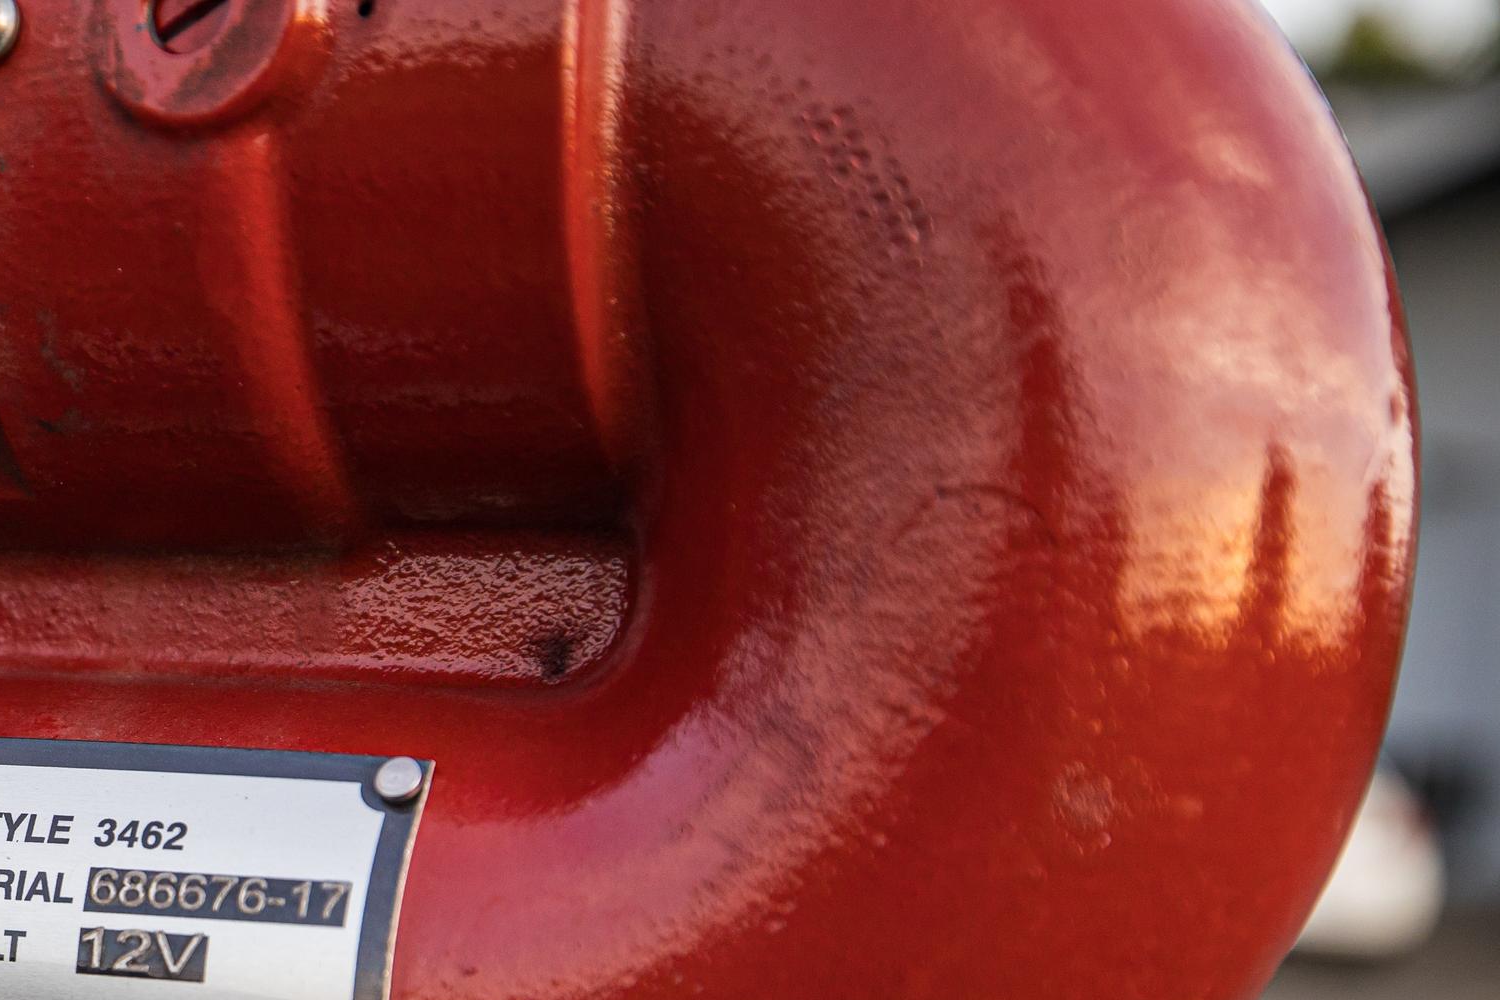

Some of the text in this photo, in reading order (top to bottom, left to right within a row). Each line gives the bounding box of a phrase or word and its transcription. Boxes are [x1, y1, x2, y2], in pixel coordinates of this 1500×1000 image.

[94, 818, 188, 851] 3462
[88, 867, 350, 922] 686676-17
[80, 926, 202, 977] 12V
